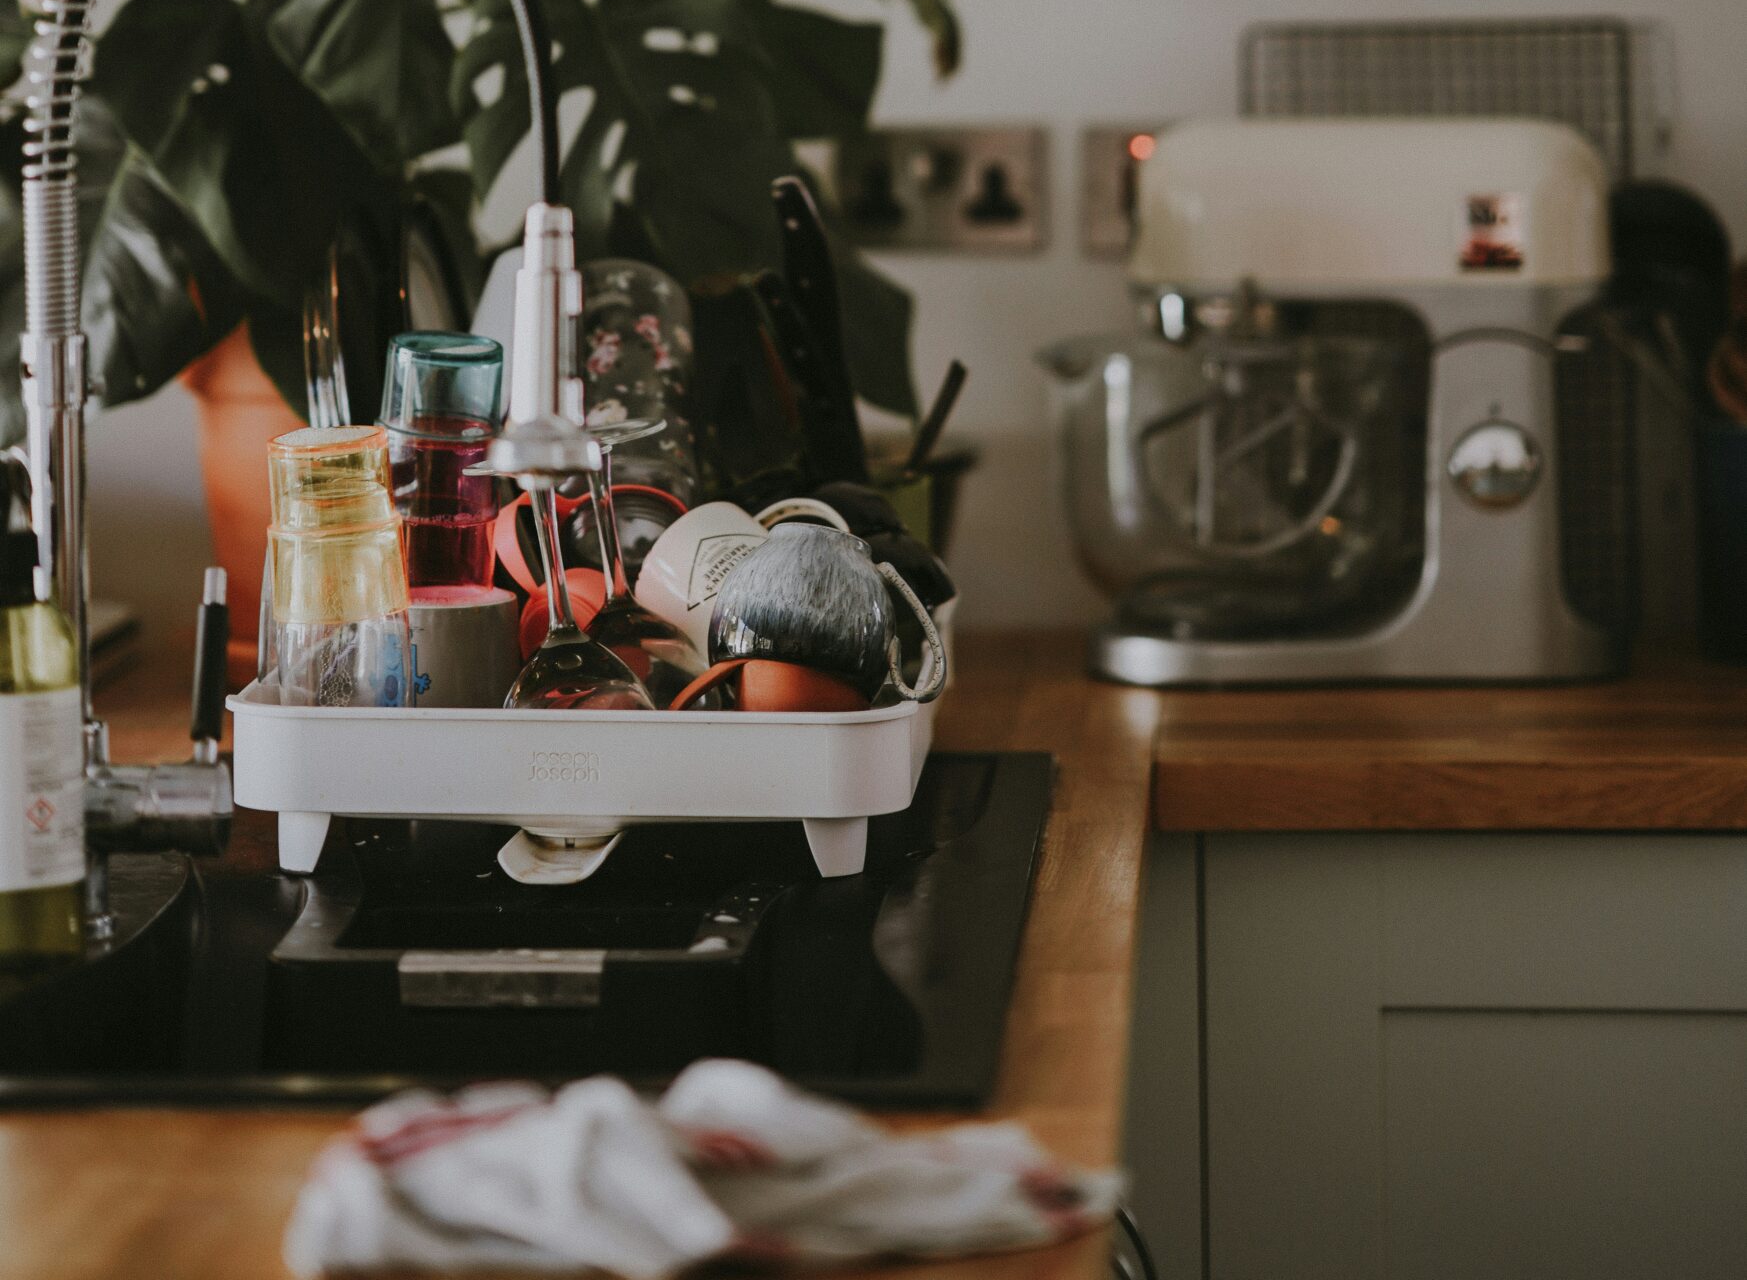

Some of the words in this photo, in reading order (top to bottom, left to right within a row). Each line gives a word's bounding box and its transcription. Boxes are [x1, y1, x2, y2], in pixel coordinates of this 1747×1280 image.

[704, 543, 747, 580] HARDWARE
[528, 751, 600, 769] Joseph
[528, 766, 600, 783] Joseph
